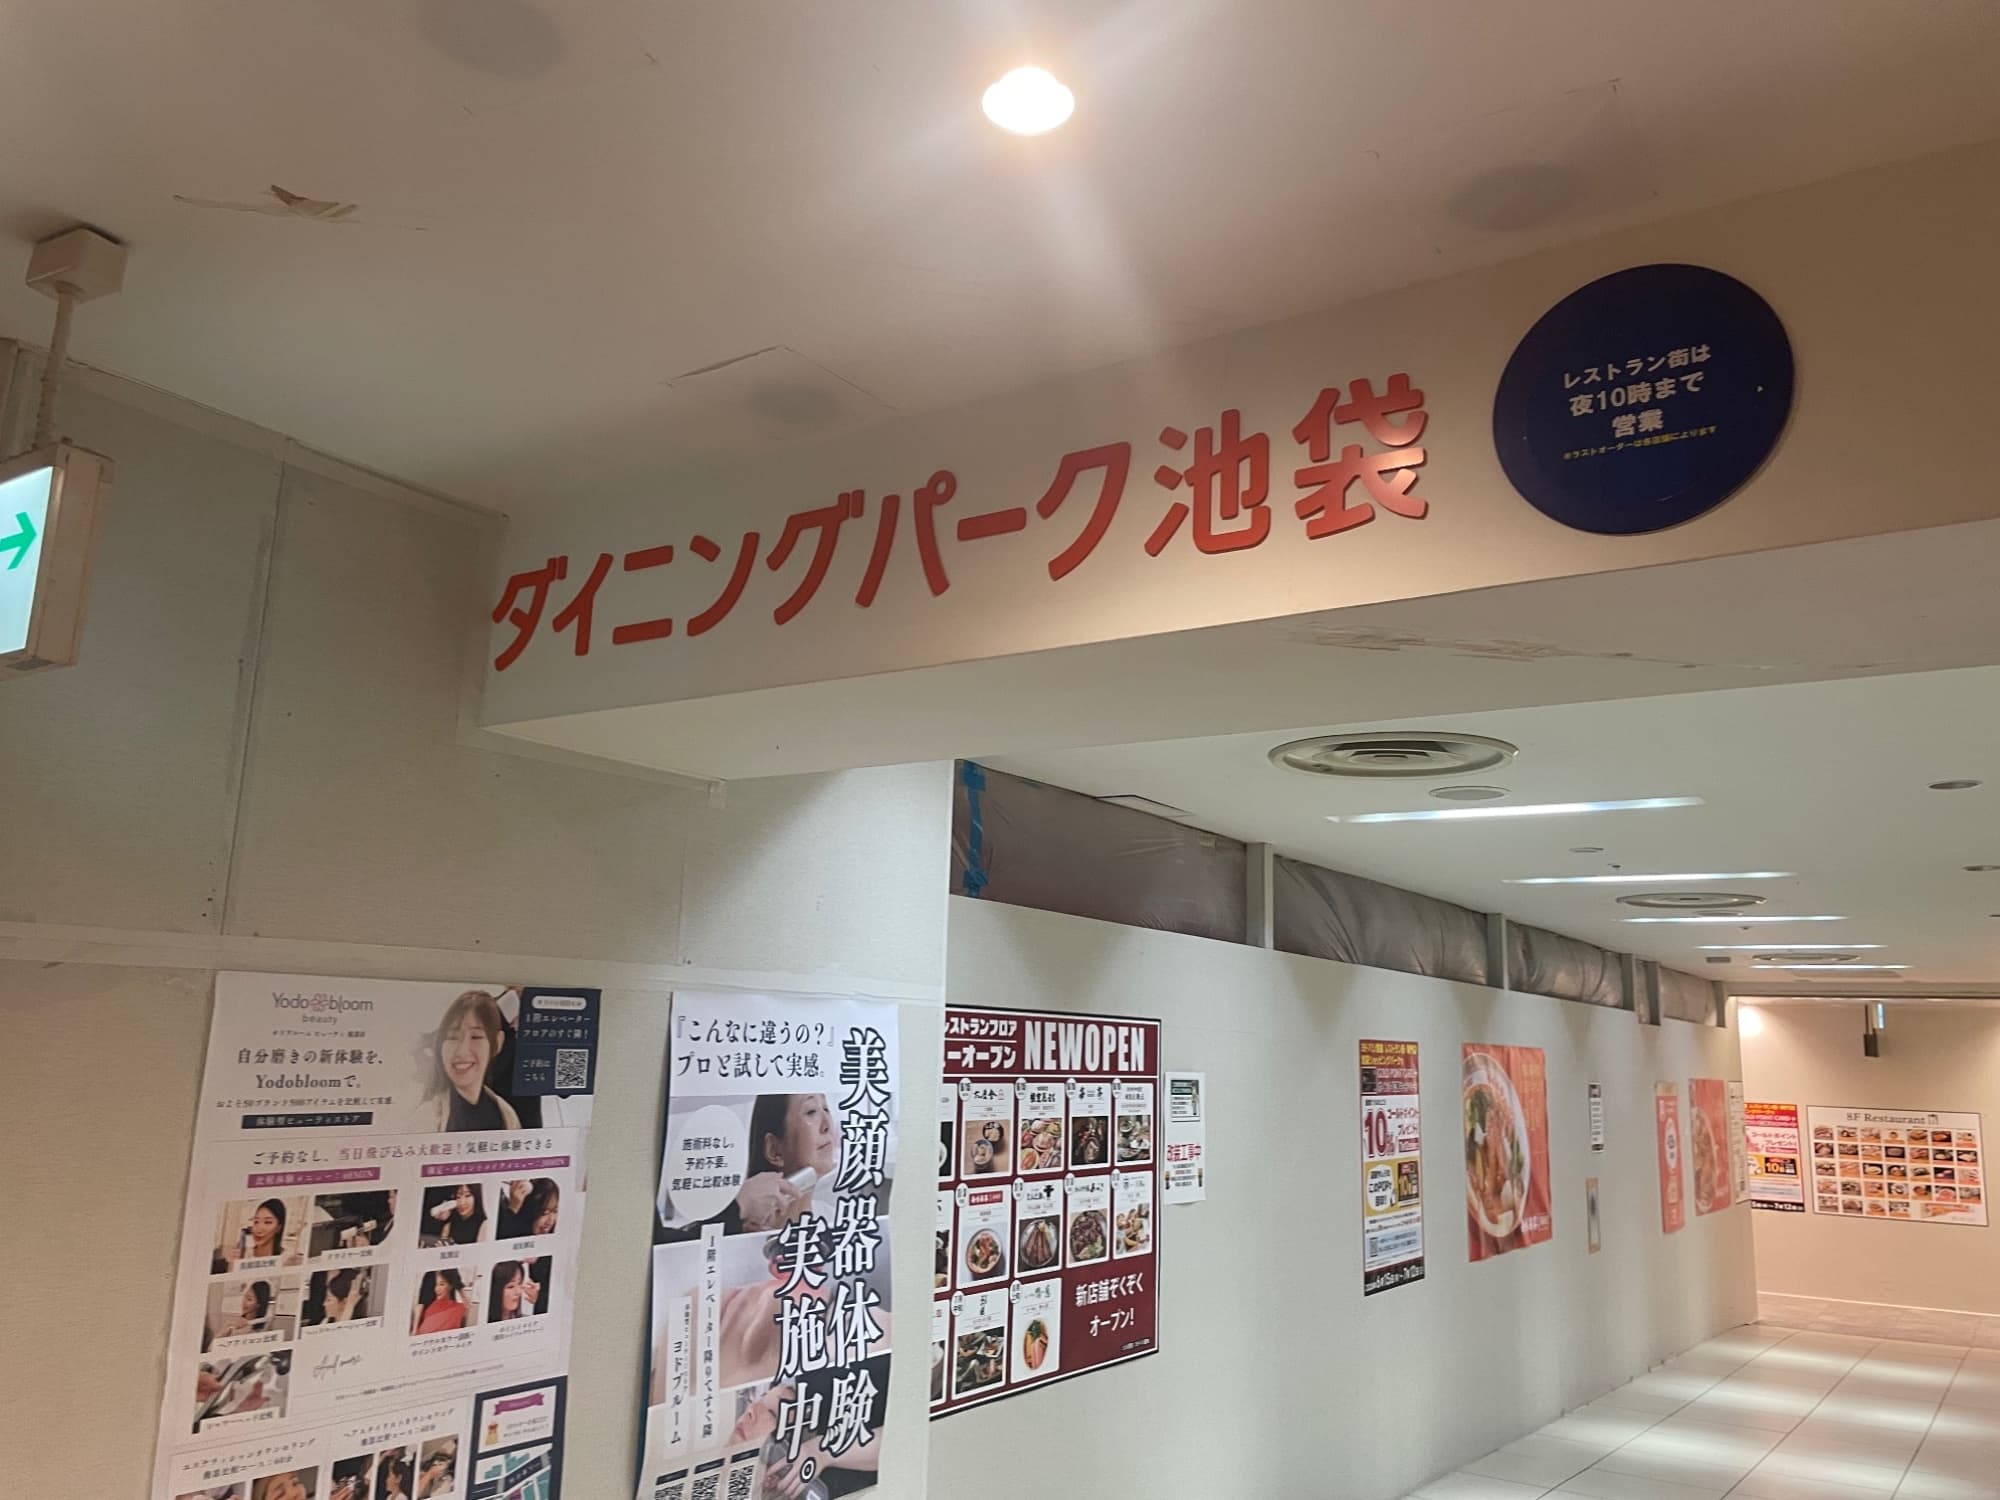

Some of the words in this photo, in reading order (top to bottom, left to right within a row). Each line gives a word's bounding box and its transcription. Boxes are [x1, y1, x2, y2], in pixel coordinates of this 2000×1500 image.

[1563, 344, 1712, 389] レストラン街は
[1569, 371, 1705, 417] 夜10時まで
[1611, 409, 1664, 438] 営業
[492, 371, 1429, 673] ダイニングパーク池袋
[301, 1013, 338, 1026] beauty
[676, 1050, 826, 1079] プロと試して実感。
[1864, 1112, 1926, 1125] Restaurant
[821, 1026, 892, 1455] 美顔器体験
[1075, 1271, 1145, 1308] 新店舗ぞくぞく
